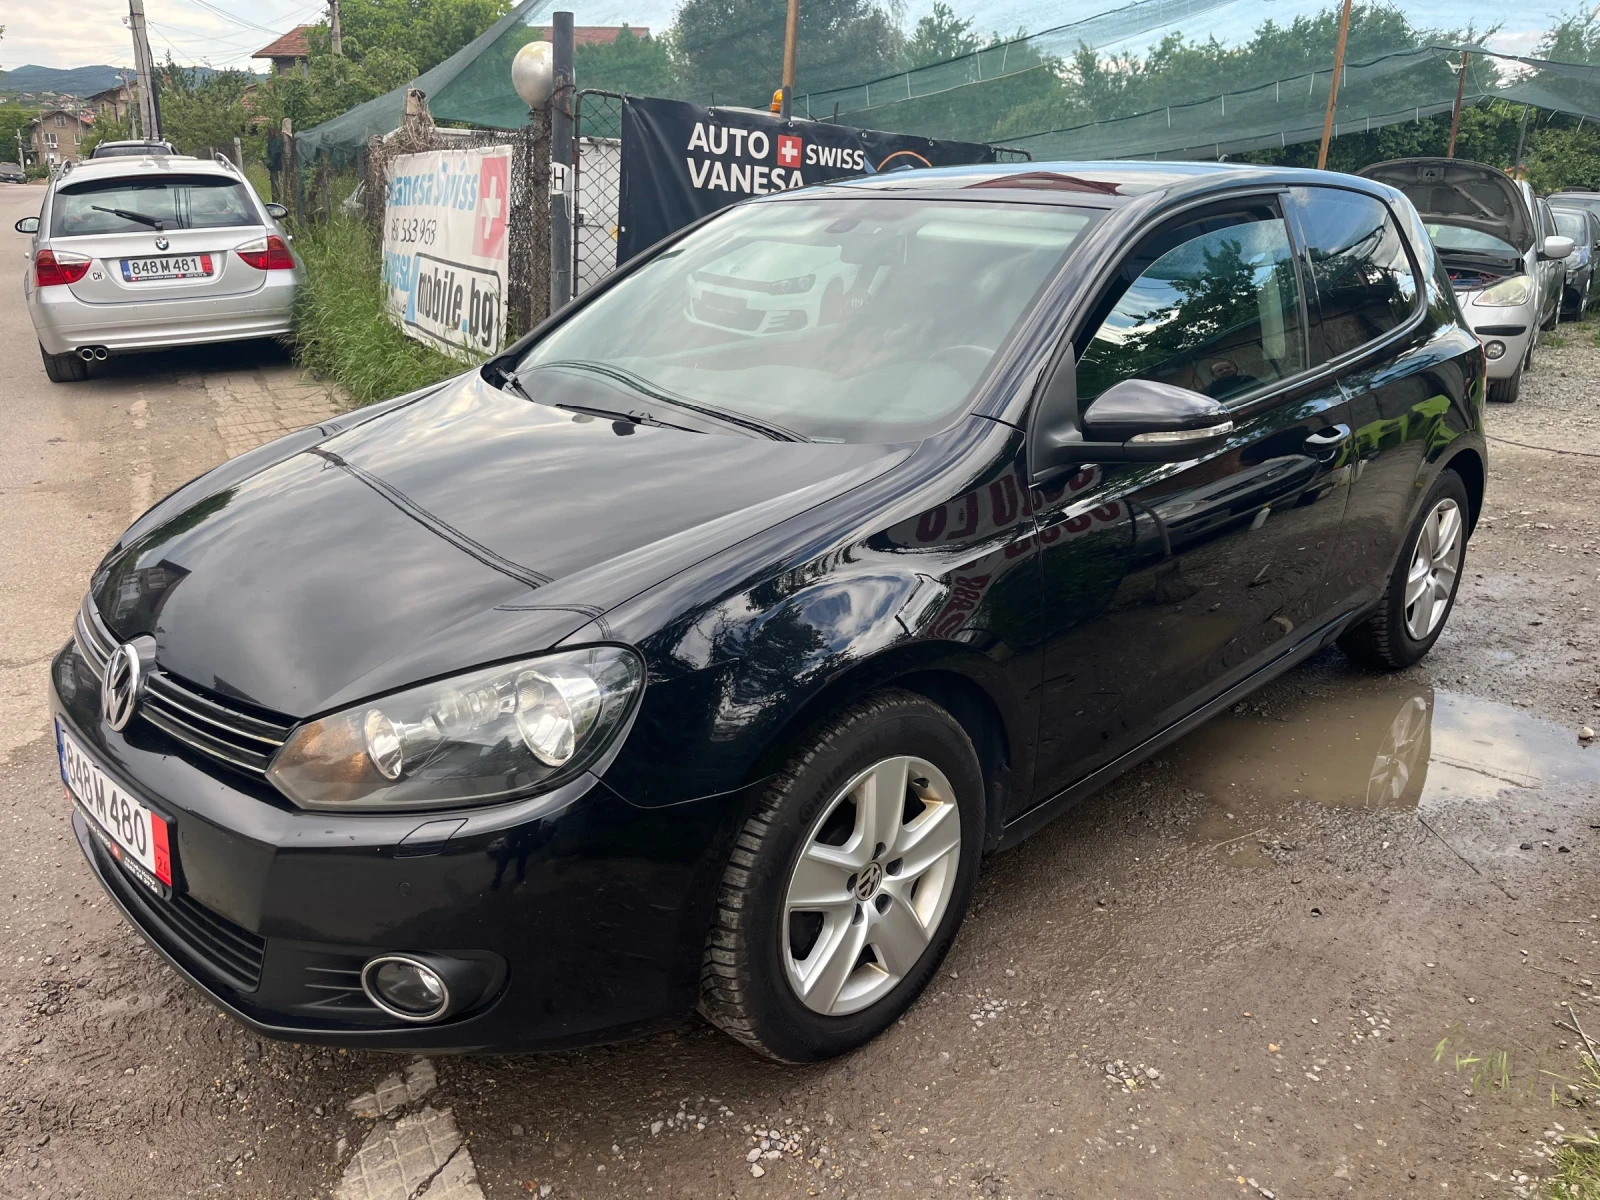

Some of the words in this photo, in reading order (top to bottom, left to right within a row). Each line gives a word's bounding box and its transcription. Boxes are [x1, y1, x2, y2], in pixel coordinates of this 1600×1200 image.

[687, 122, 770, 160] AUTO
[805, 144, 864, 171] SWISS
[433, 160, 478, 211] Swiss
[686, 157, 804, 195] VANESA
[92, 272, 103, 281] CH
[132, 260, 159, 275] 848
[160, 259, 171, 273] M
[173, 257, 198, 272] 481
[417, 267, 494, 348] mobile.bg
[66, 741, 93, 806] 848
[93, 769, 107, 824] M
[110, 789, 146, 857] 480
